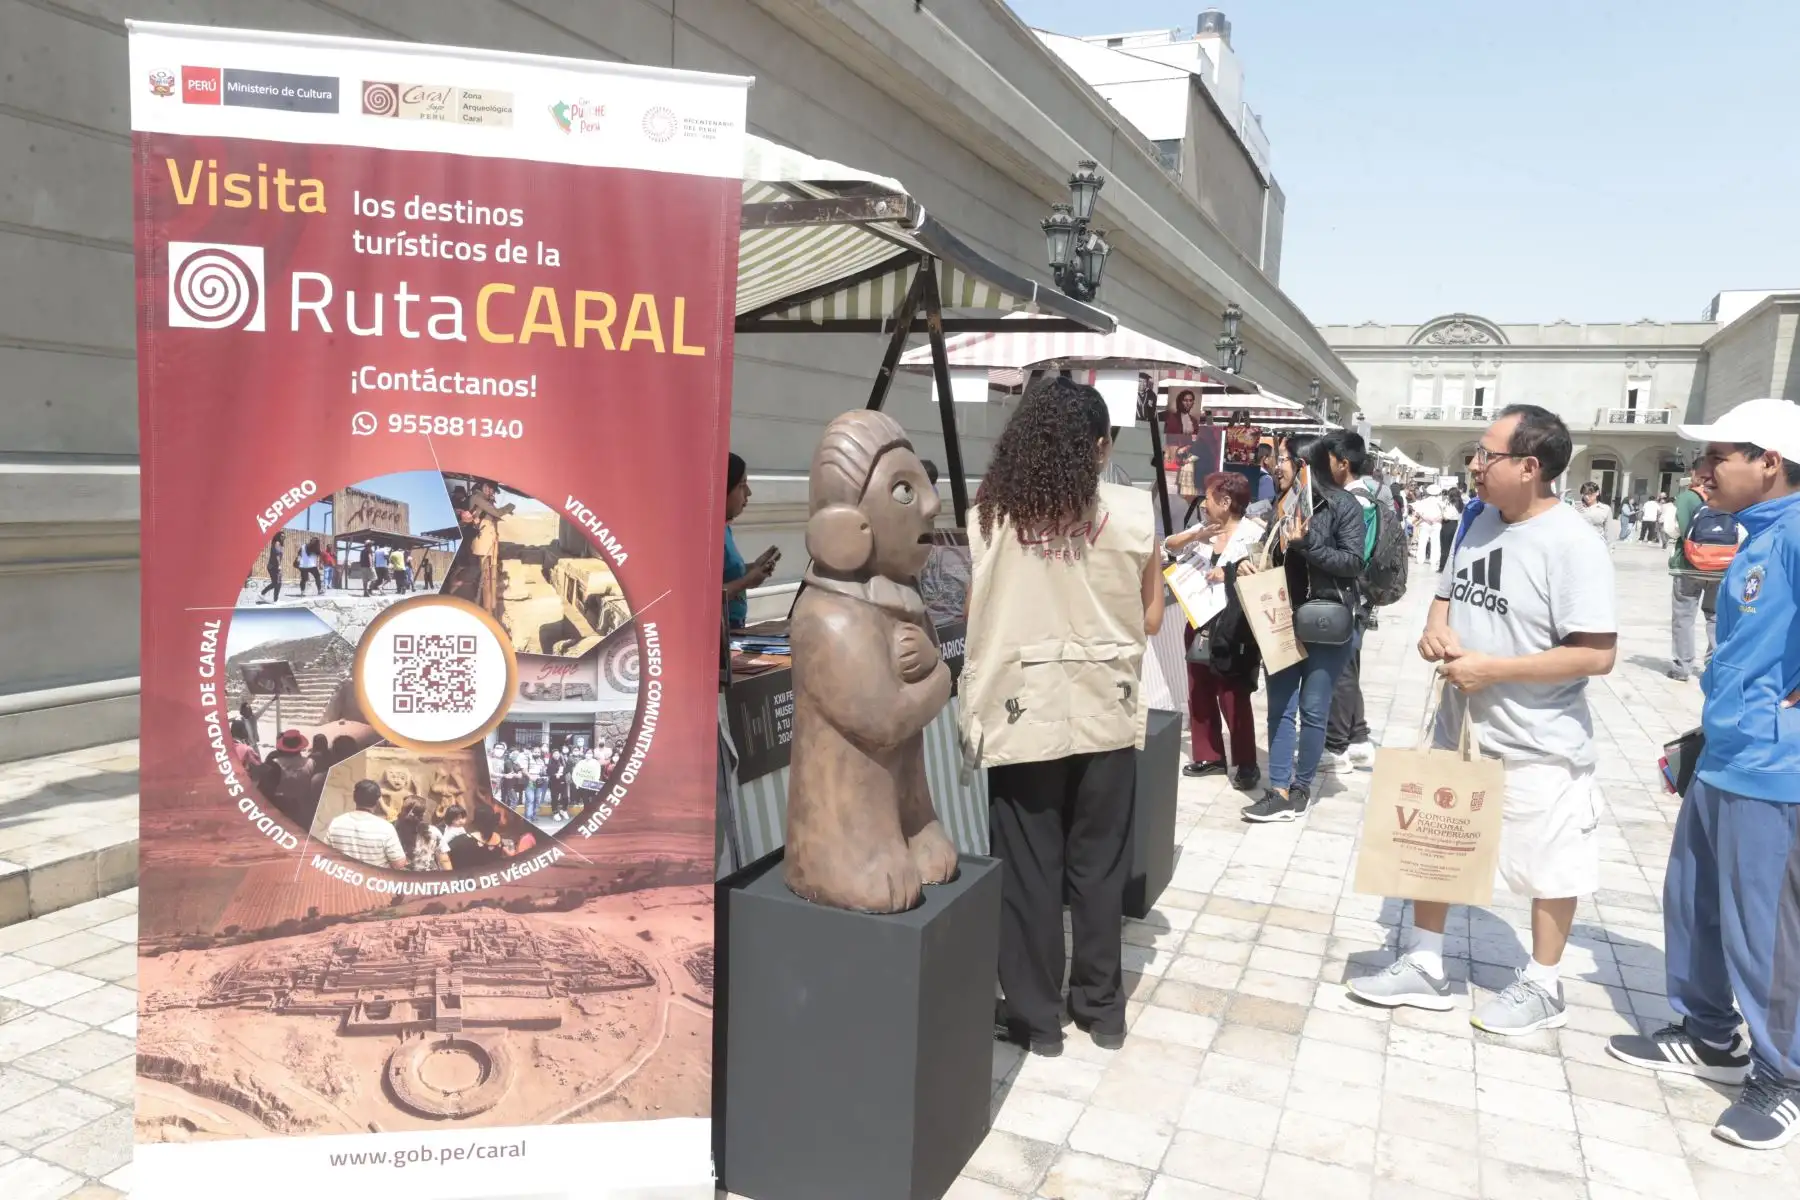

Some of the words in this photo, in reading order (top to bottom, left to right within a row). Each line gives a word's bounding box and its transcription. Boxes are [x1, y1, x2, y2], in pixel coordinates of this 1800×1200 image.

[188, 79, 217, 92] PERÚ
[227, 82, 279, 96] Ministerio
[281, 86, 295, 97] de
[297, 88, 333, 100] Cultura
[402, 85, 452, 104] Caral
[462, 91, 482, 100] Zona
[462, 103, 513, 114] Arqueológica
[462, 114, 483, 123] Caral
[166, 158, 327, 214] Visita
[353, 190, 396, 218] los
[403, 195, 525, 229] destinos
[352, 229, 487, 262] turísticos
[494, 238, 529, 265] de
[536, 241, 561, 268] la
[351, 366, 538, 398] ¡Contáctanos!
[387, 413, 524, 440] 955881340
[255, 479, 318, 534] ÁSPERO
[563, 494, 629, 568] VICHAMA
[199, 619, 221, 678] CARAL
[643, 622, 662, 676] MUSEO
[200, 682, 217, 707] DE
[775, 704, 794, 718] MUSE
[620, 680, 662, 785] COMUNITARIO
[204, 710, 244, 797] SAGRADA
[606, 784, 627, 806] DE
[238, 797, 299, 850] CIUDAD
[577, 803, 613, 839] SUPE
[1394, 805, 1420, 831] V
[1417, 818, 1465, 832] NACIONAL
[1419, 811, 1471, 825] CONGRESO
[310, 854, 365, 886] MUSEO
[366, 876, 477, 896] COMUNITARIO
[479, 872, 501, 890] DE
[501, 846, 566, 884] VÉGUETA
[329, 1140, 527, 1168] www.gob.pe/caral
